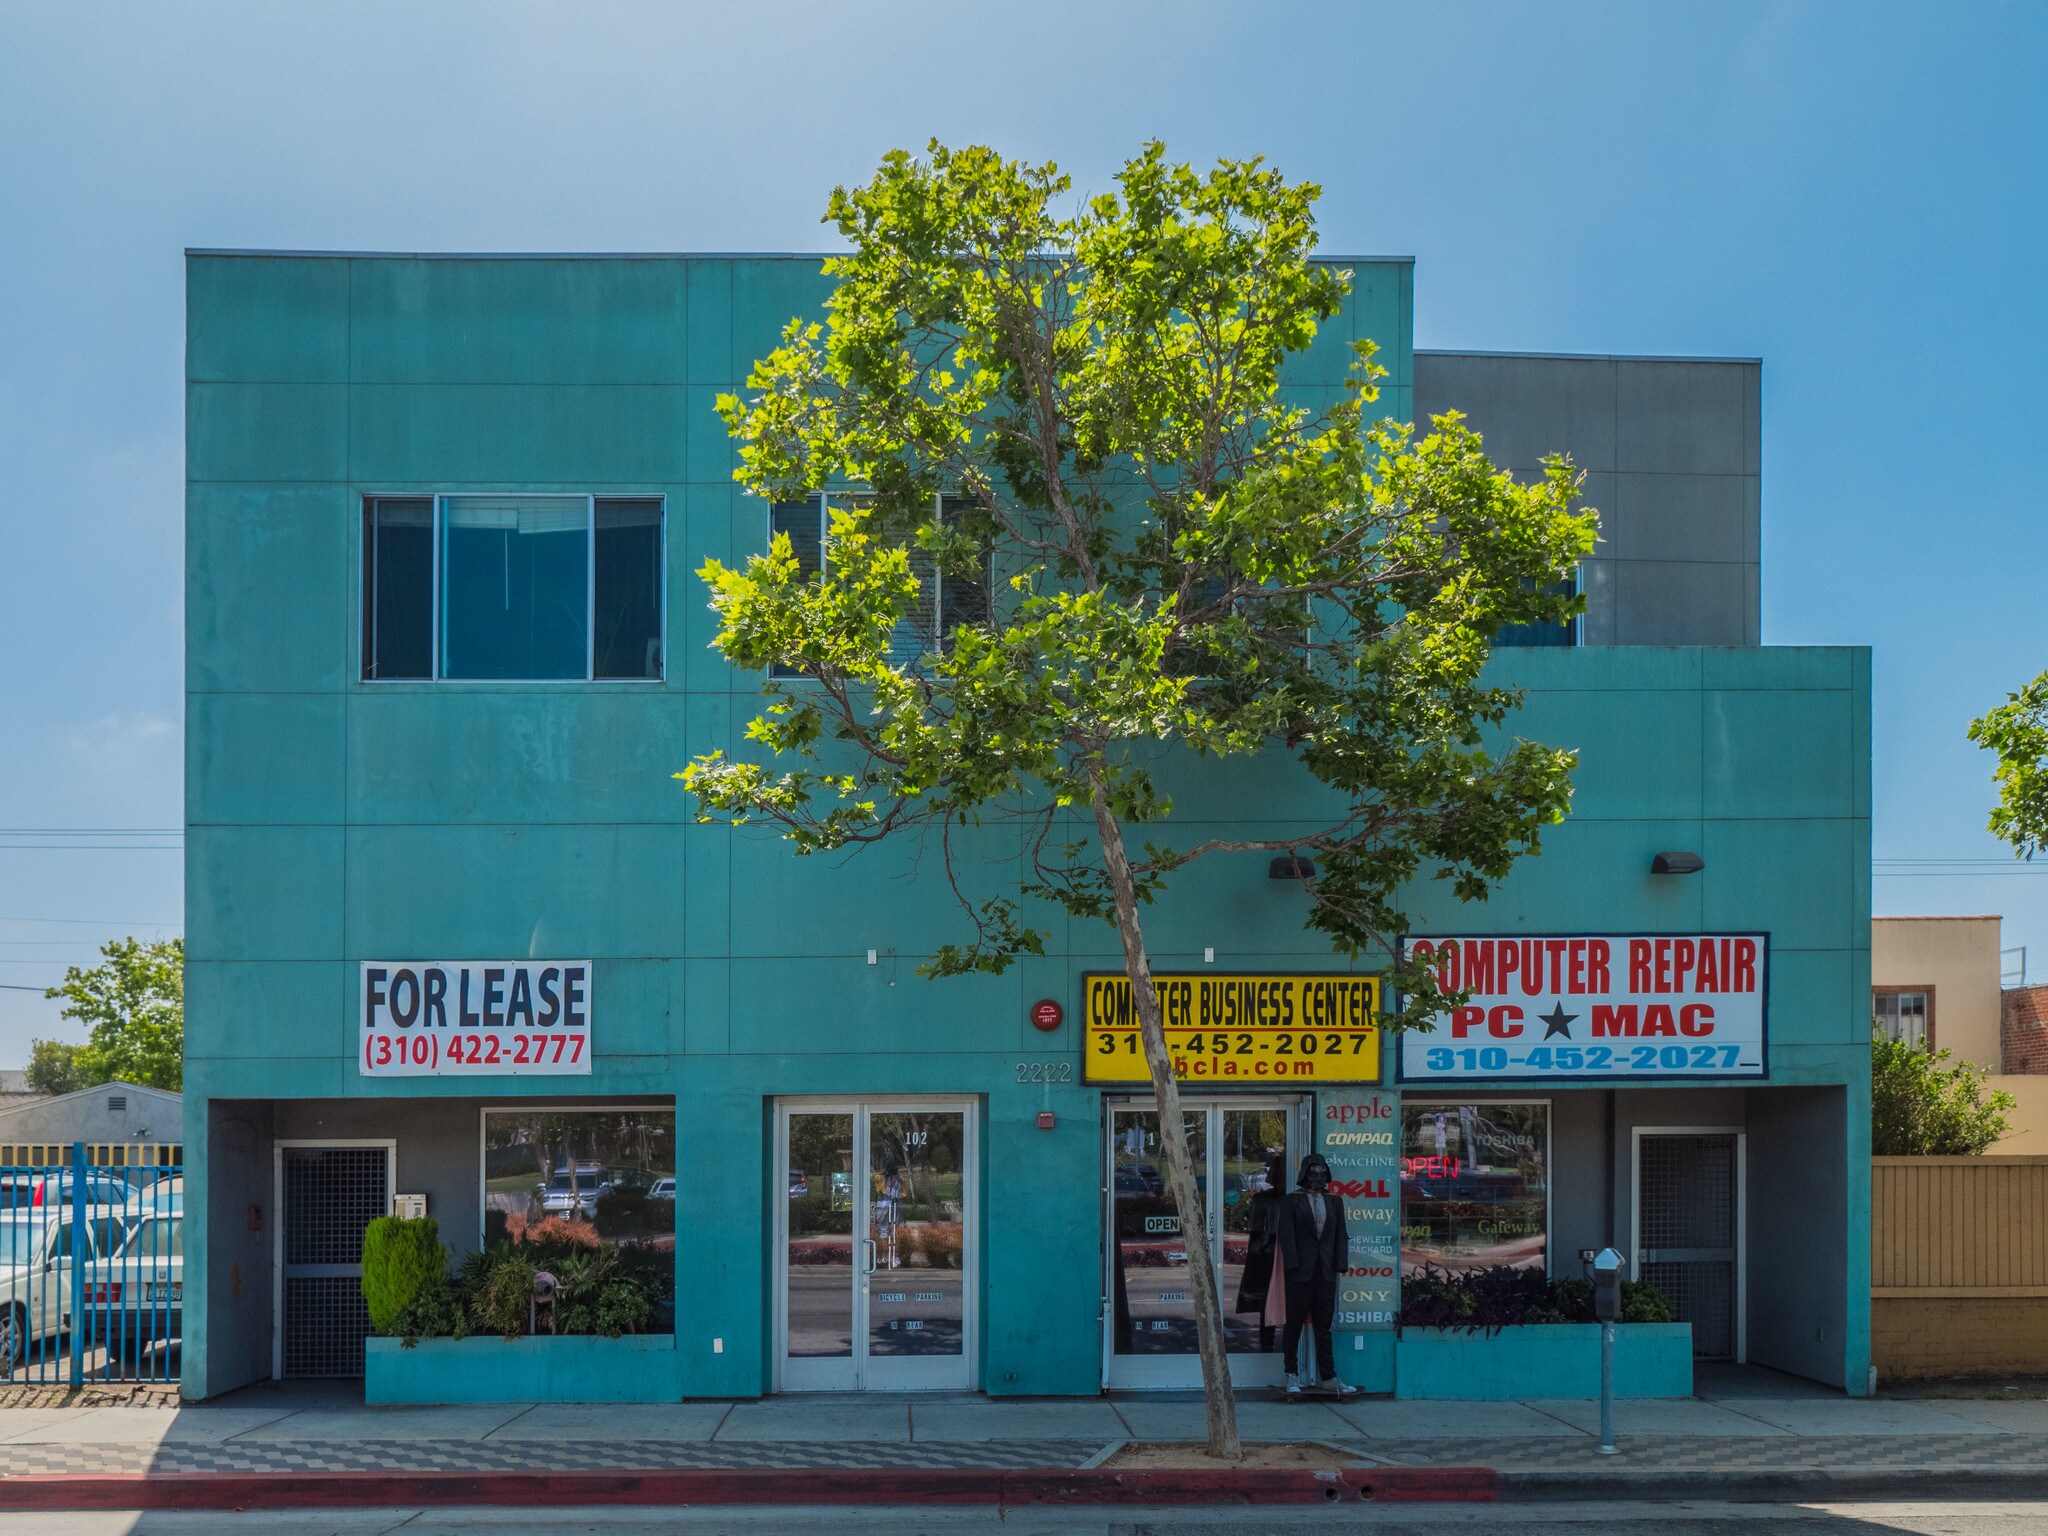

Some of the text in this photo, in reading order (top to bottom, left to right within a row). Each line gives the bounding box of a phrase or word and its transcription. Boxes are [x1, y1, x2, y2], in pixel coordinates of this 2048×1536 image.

[1629, 938, 1756, 993] REPAIR
[366, 967, 585, 1028] FOR LEASE
[1092, 981, 1373, 1026] COMTER BUSINESS CENTER
[1452, 1003, 1715, 1038] PC MAC
[365, 1034, 585, 1069] (310) 422-2777
[1098, 1033, 1367, 1055] 31-452-2027
[1426, 1045, 1741, 1070] 310-452-2027
[1016, 1062, 1072, 1083] 2222
[1325, 1096, 1393, 1124] apple
[905, 1132, 928, 1145] 102
[1325, 1132, 1394, 1146] COMPAQ
[1328, 1180, 1391, 1199] DELL
[1147, 1218, 1179, 1231] OPEN
[1346, 1206, 1395, 1225] teway
[1477, 1220, 1541, 1236] Gateway
[1349, 1245, 1393, 1254] PACKARD
[1342, 1266, 1393, 1278] novo
[880, 1292, 943, 1302] BICYCLE PARKING
[1160, 1293, 1185, 1301] PARKING
[1339, 1290, 1390, 1302] ONY
